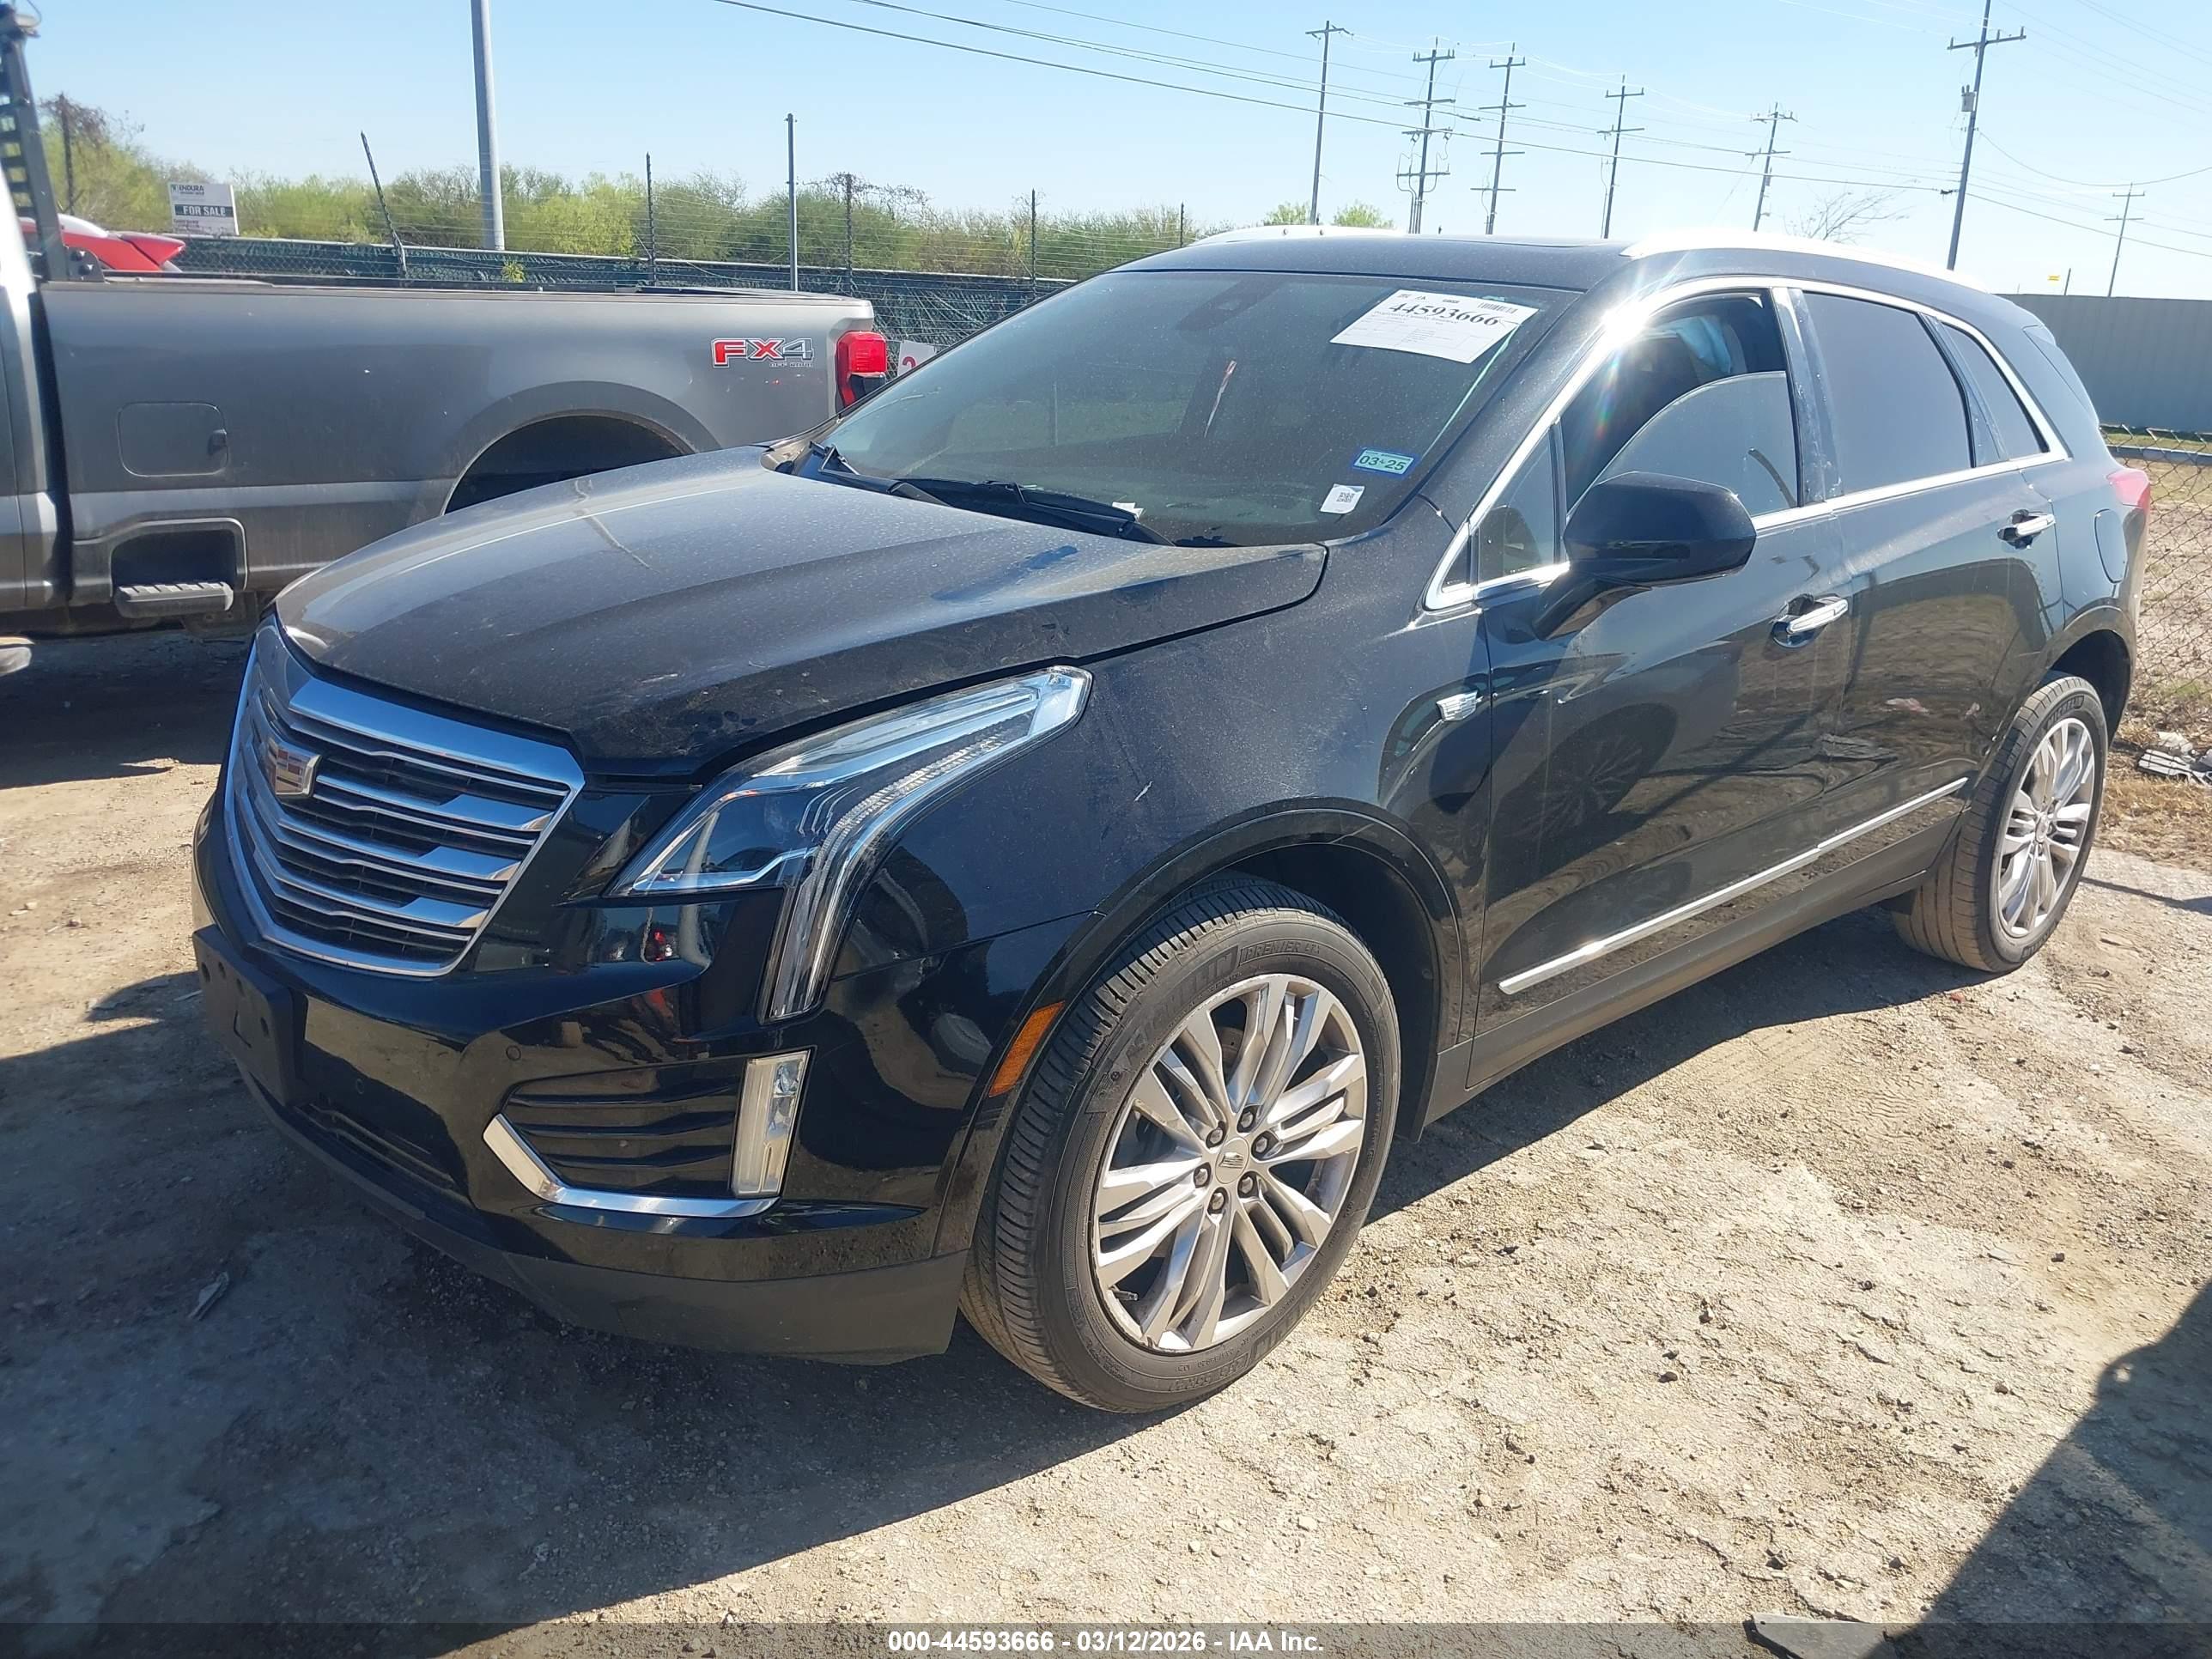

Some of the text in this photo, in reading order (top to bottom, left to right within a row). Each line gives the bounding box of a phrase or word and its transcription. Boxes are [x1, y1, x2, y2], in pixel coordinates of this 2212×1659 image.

[183, 205, 227, 216] FOR SALE
[1389, 302, 1500, 326] 44593666
[712, 338, 814, 368] FX4
[1359, 455, 1380, 466] 03
[1384, 459, 1407, 471] 25
